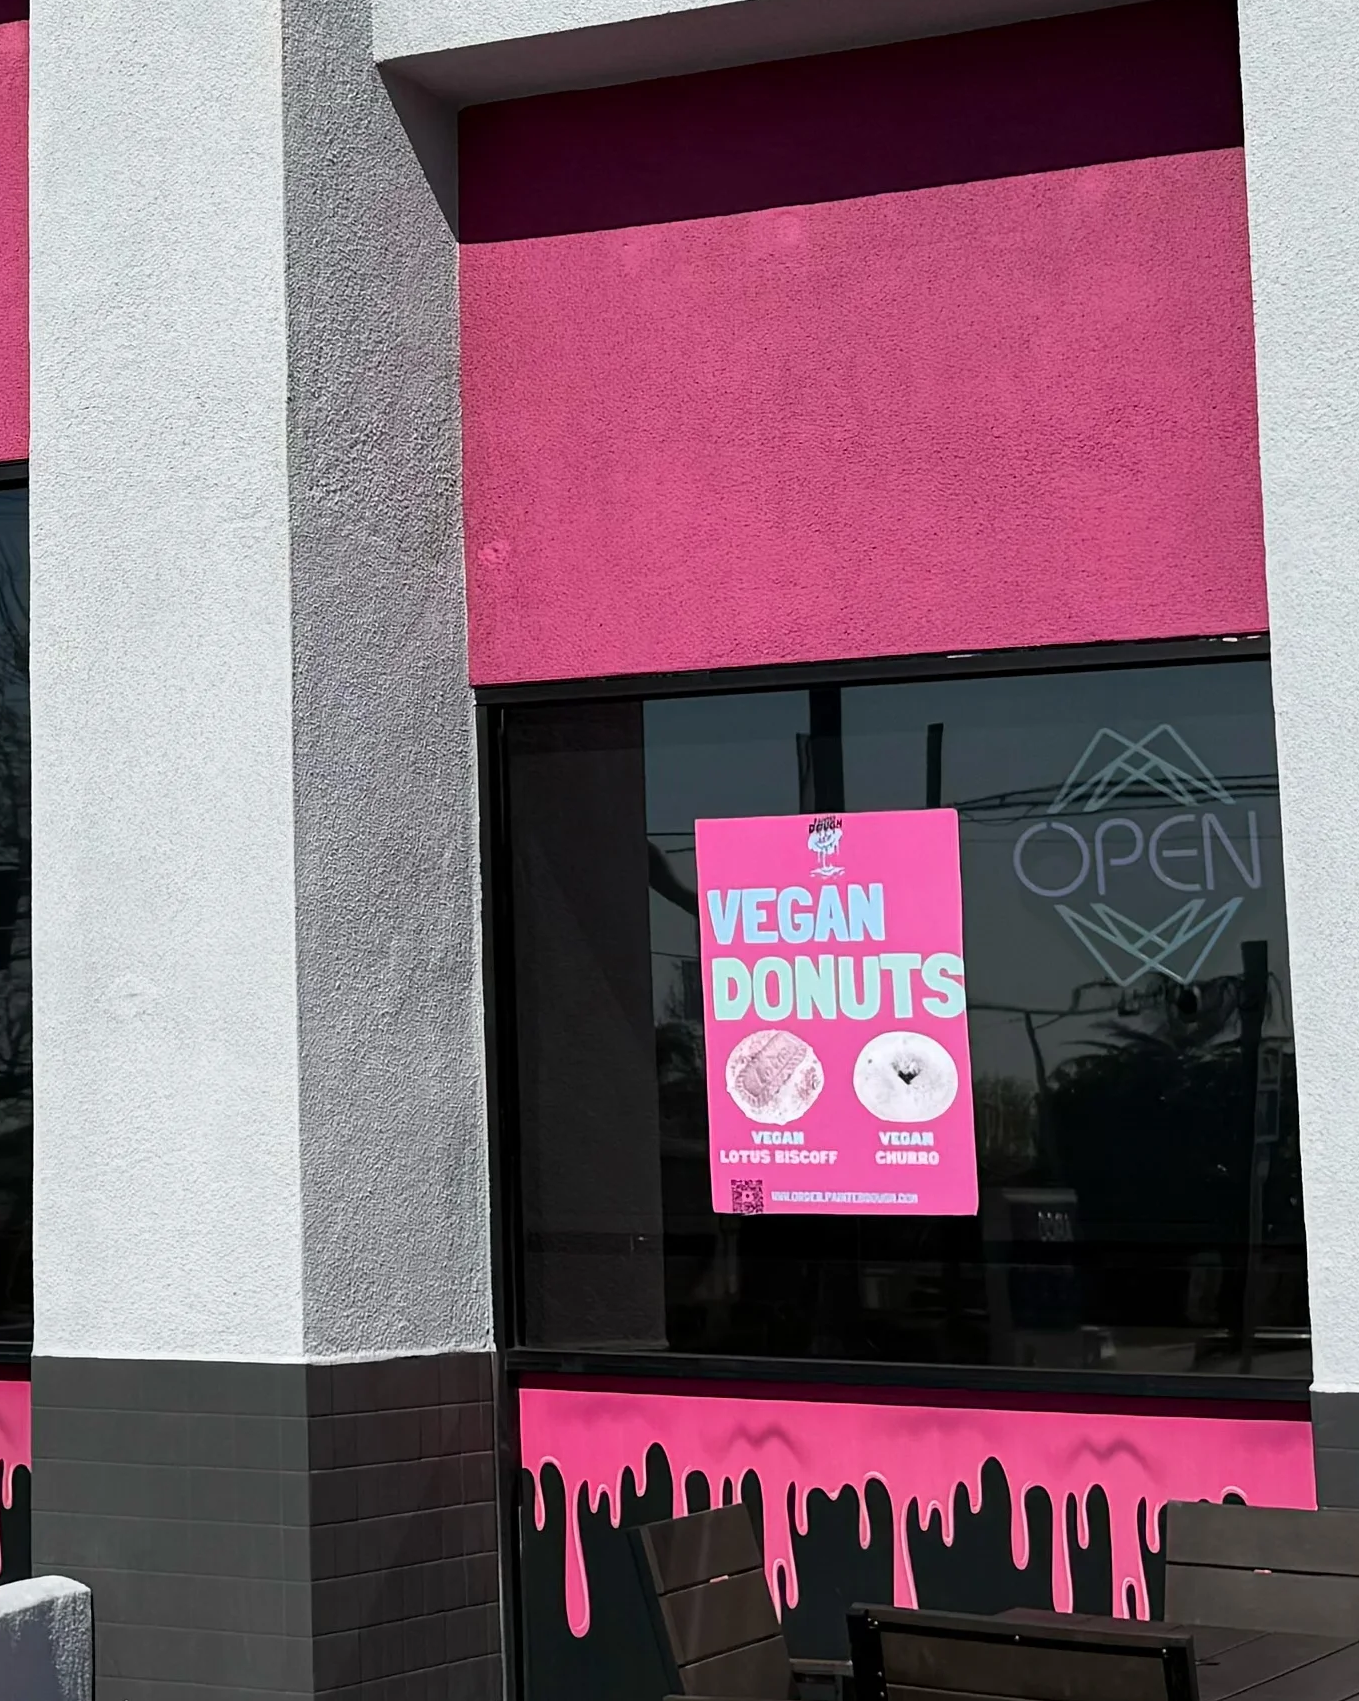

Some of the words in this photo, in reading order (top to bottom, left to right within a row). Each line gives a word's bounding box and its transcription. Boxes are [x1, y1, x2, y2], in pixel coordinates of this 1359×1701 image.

[1012, 810, 1262, 898] OPEN
[706, 883, 885, 945] VEGAN
[711, 951, 966, 1022] DONUTS
[751, 1130, 805, 1146] VEGAN
[879, 1131, 935, 1146] VEGAN
[719, 1149, 772, 1165] LOTUS
[774, 1149, 839, 1165] BISCOFF
[874, 1150, 941, 1166] CHURRO
